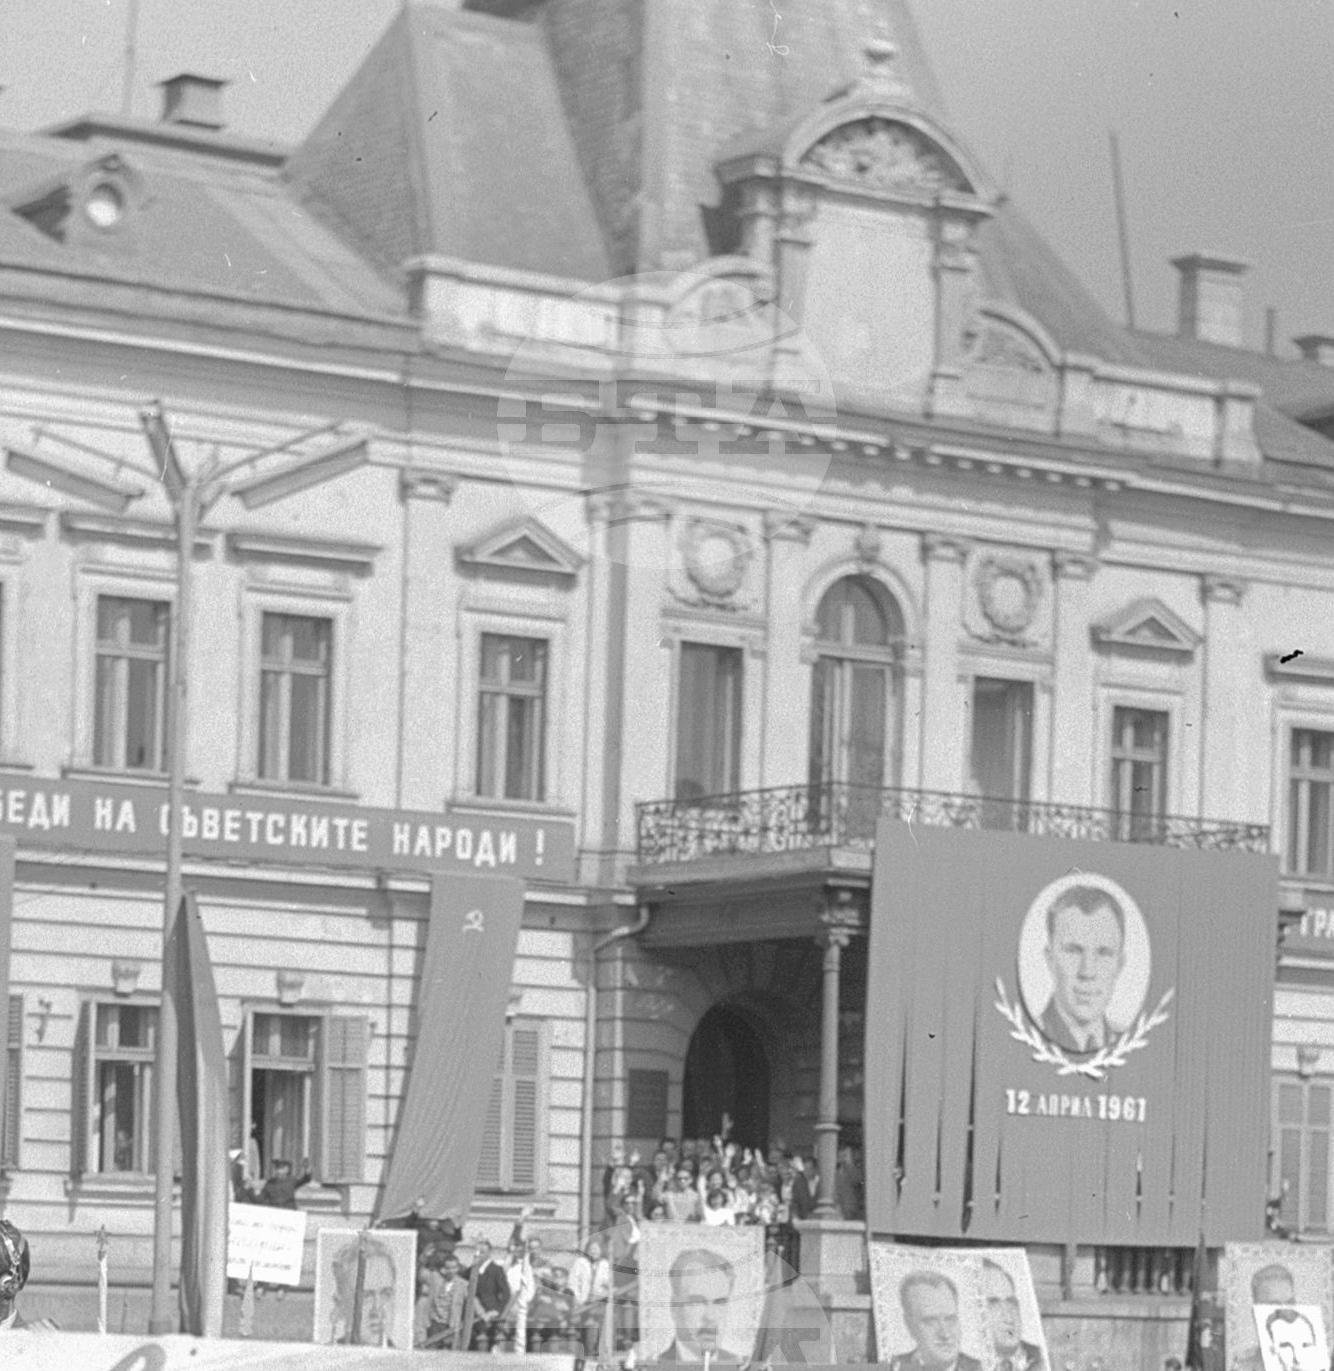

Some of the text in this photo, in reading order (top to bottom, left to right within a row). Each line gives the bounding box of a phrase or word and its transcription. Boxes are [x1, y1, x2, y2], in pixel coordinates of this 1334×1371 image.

[94, 798, 136, 835] НА
[392, 821, 517, 870] НАРОДИ
[1005, 1089, 1147, 1122] 12 АПРИЛ 1961
